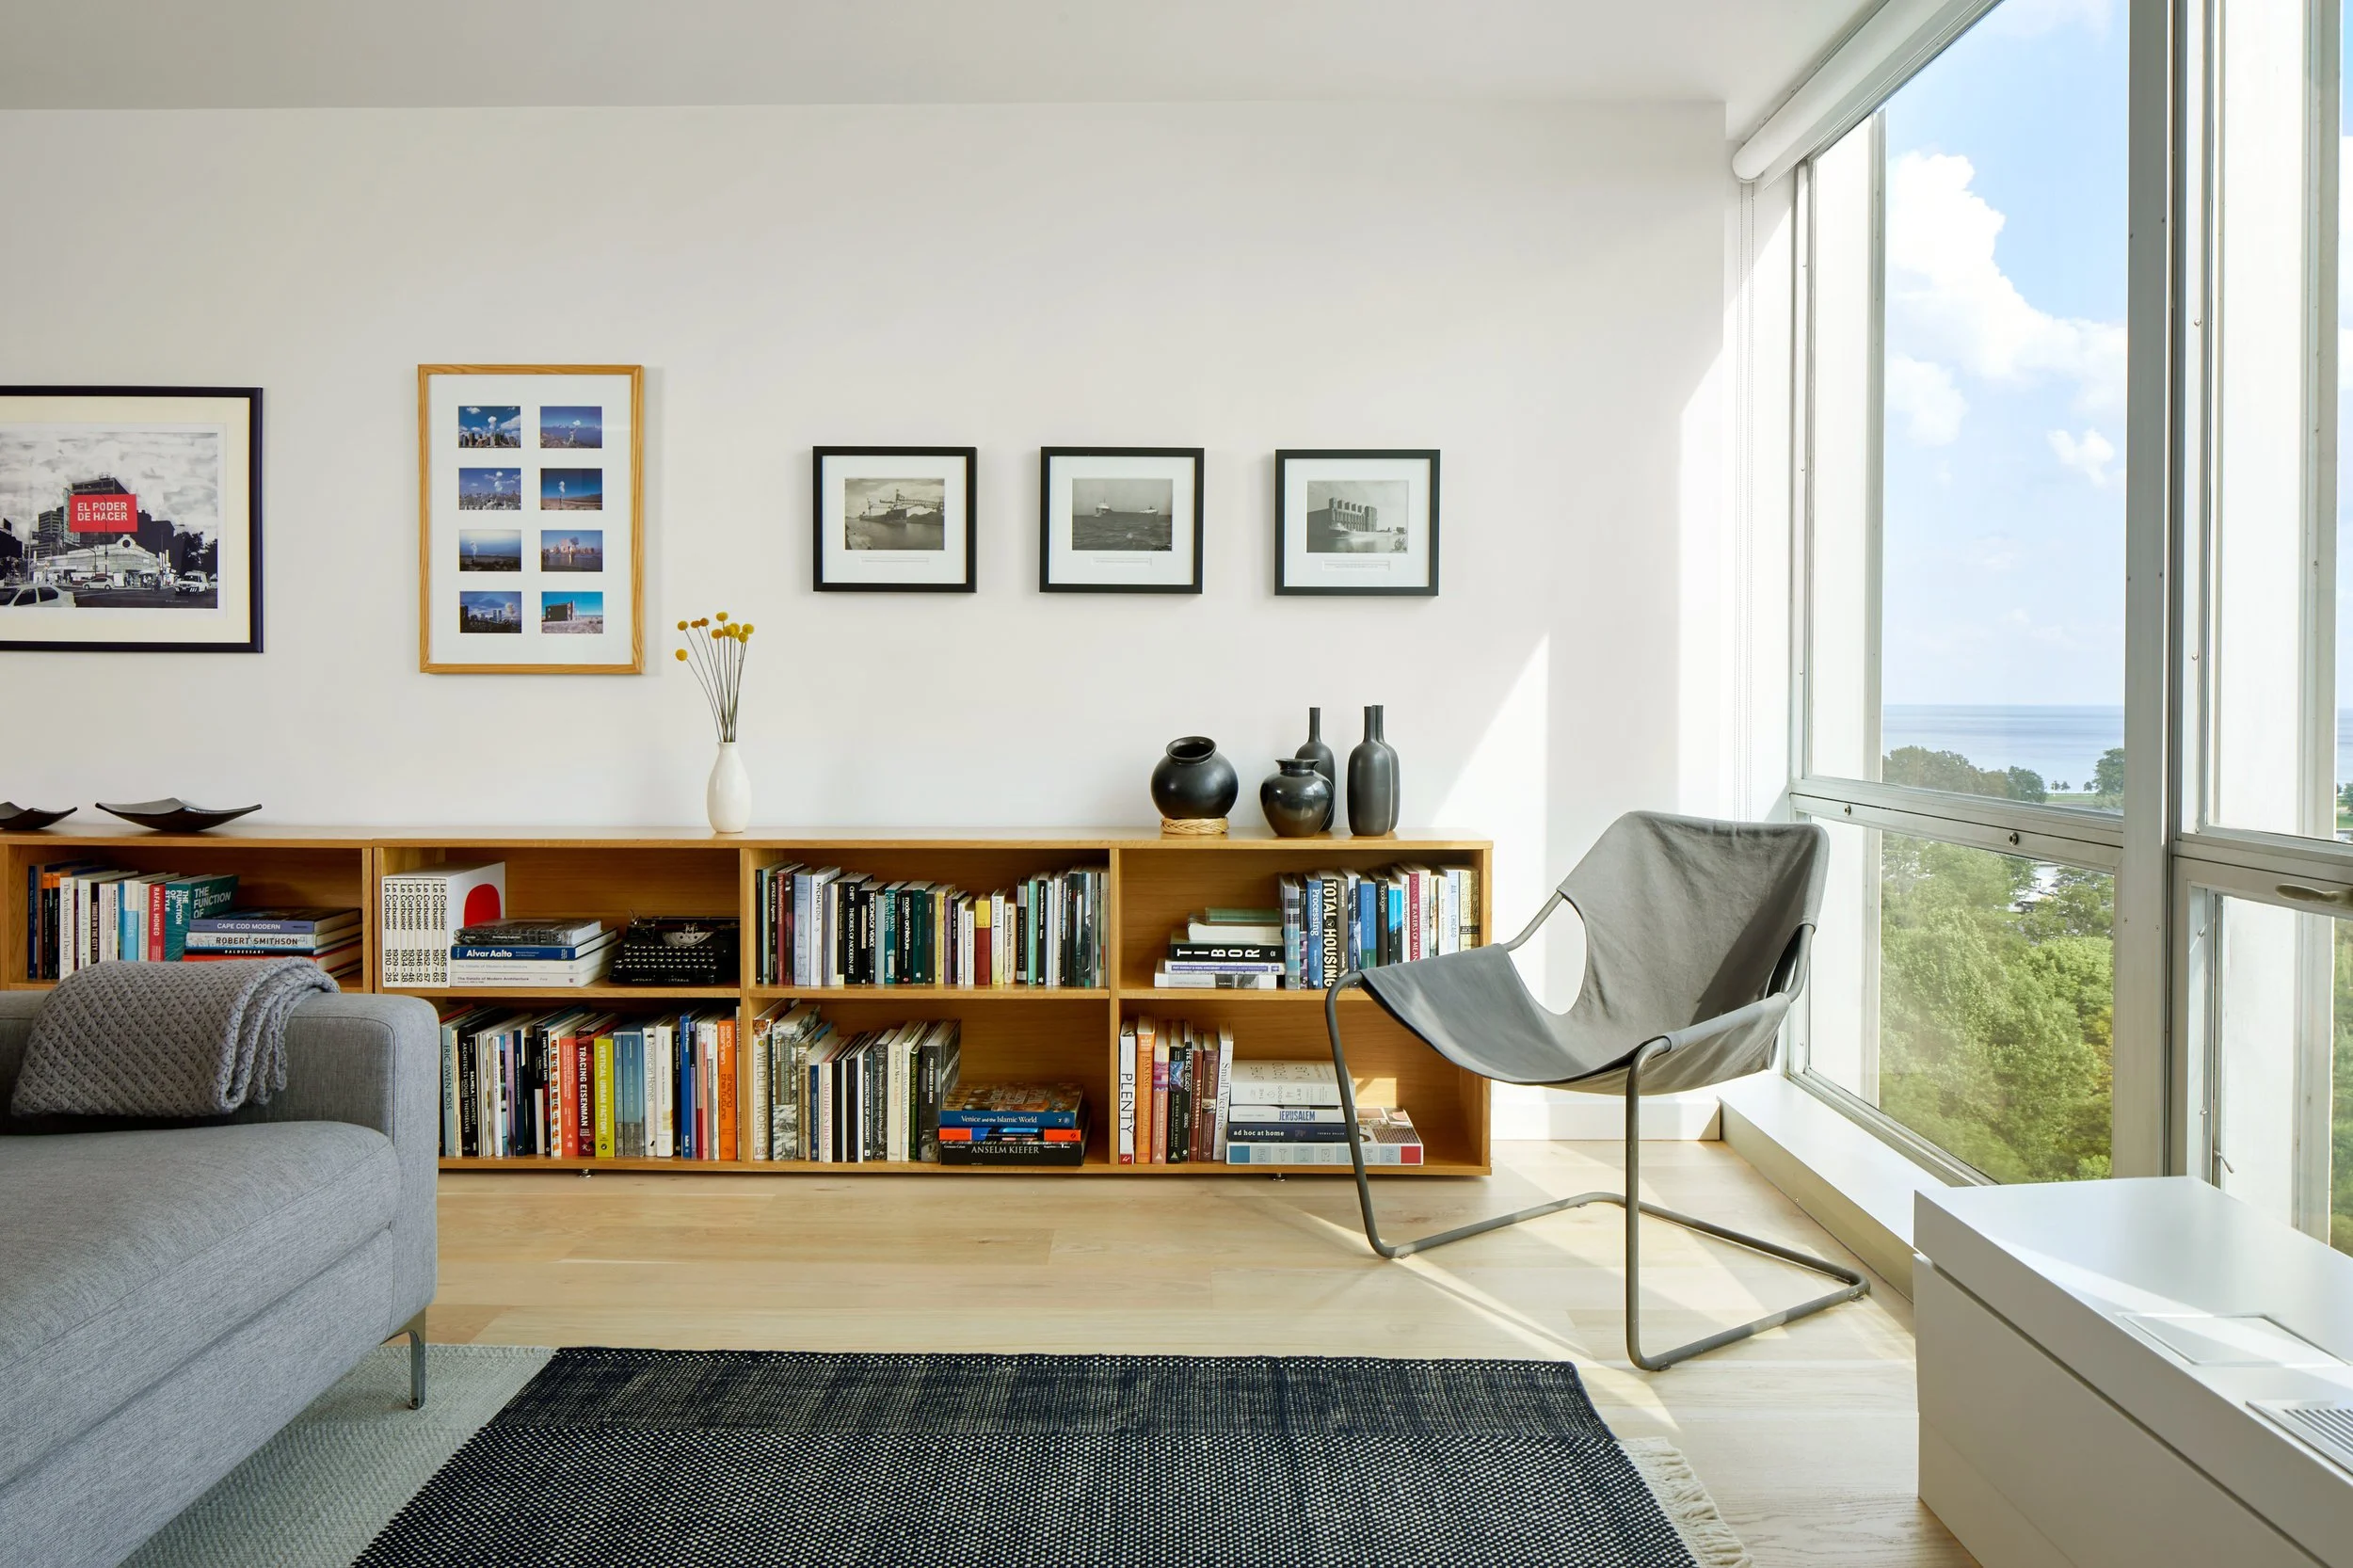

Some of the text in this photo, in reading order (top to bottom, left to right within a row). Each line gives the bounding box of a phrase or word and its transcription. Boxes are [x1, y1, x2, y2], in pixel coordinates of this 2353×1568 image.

[77, 503, 127, 511] EL PODER
[77, 512, 127, 520] DE HACER
[194, 886, 210, 899] THE
[384, 883, 392, 893] Le
[392, 883, 398, 893] Le
[401, 883, 407, 893] Le
[408, 883, 414, 893] Le
[416, 883, 423, 893] Le
[424, 883, 430, 893] Le
[433, 883, 440, 893] Le
[440, 883, 447, 893] Le
[170, 889, 176, 900] OF
[1379, 885, 1387, 913] Topologies
[193, 891, 232, 909] FUNCTION
[194, 909, 204, 919] OF
[1310, 888, 1321, 936] Processing
[1323, 881, 1337, 987] TOTAL HOUSING
[216, 936, 249, 945] ROBERT
[1176, 948, 1260, 958] TIBOR
[579, 1047, 588, 1127] TRACING EISENMAN
[757, 1052, 766, 1144] WILDLIFE WORLD
[1217, 1063, 1229, 1131] Small Victories
[1121, 1073, 1132, 1133] PLENTY
[1279, 1111, 1316, 1121] JERUSALEM
[755, 1146, 767, 1155] DK
